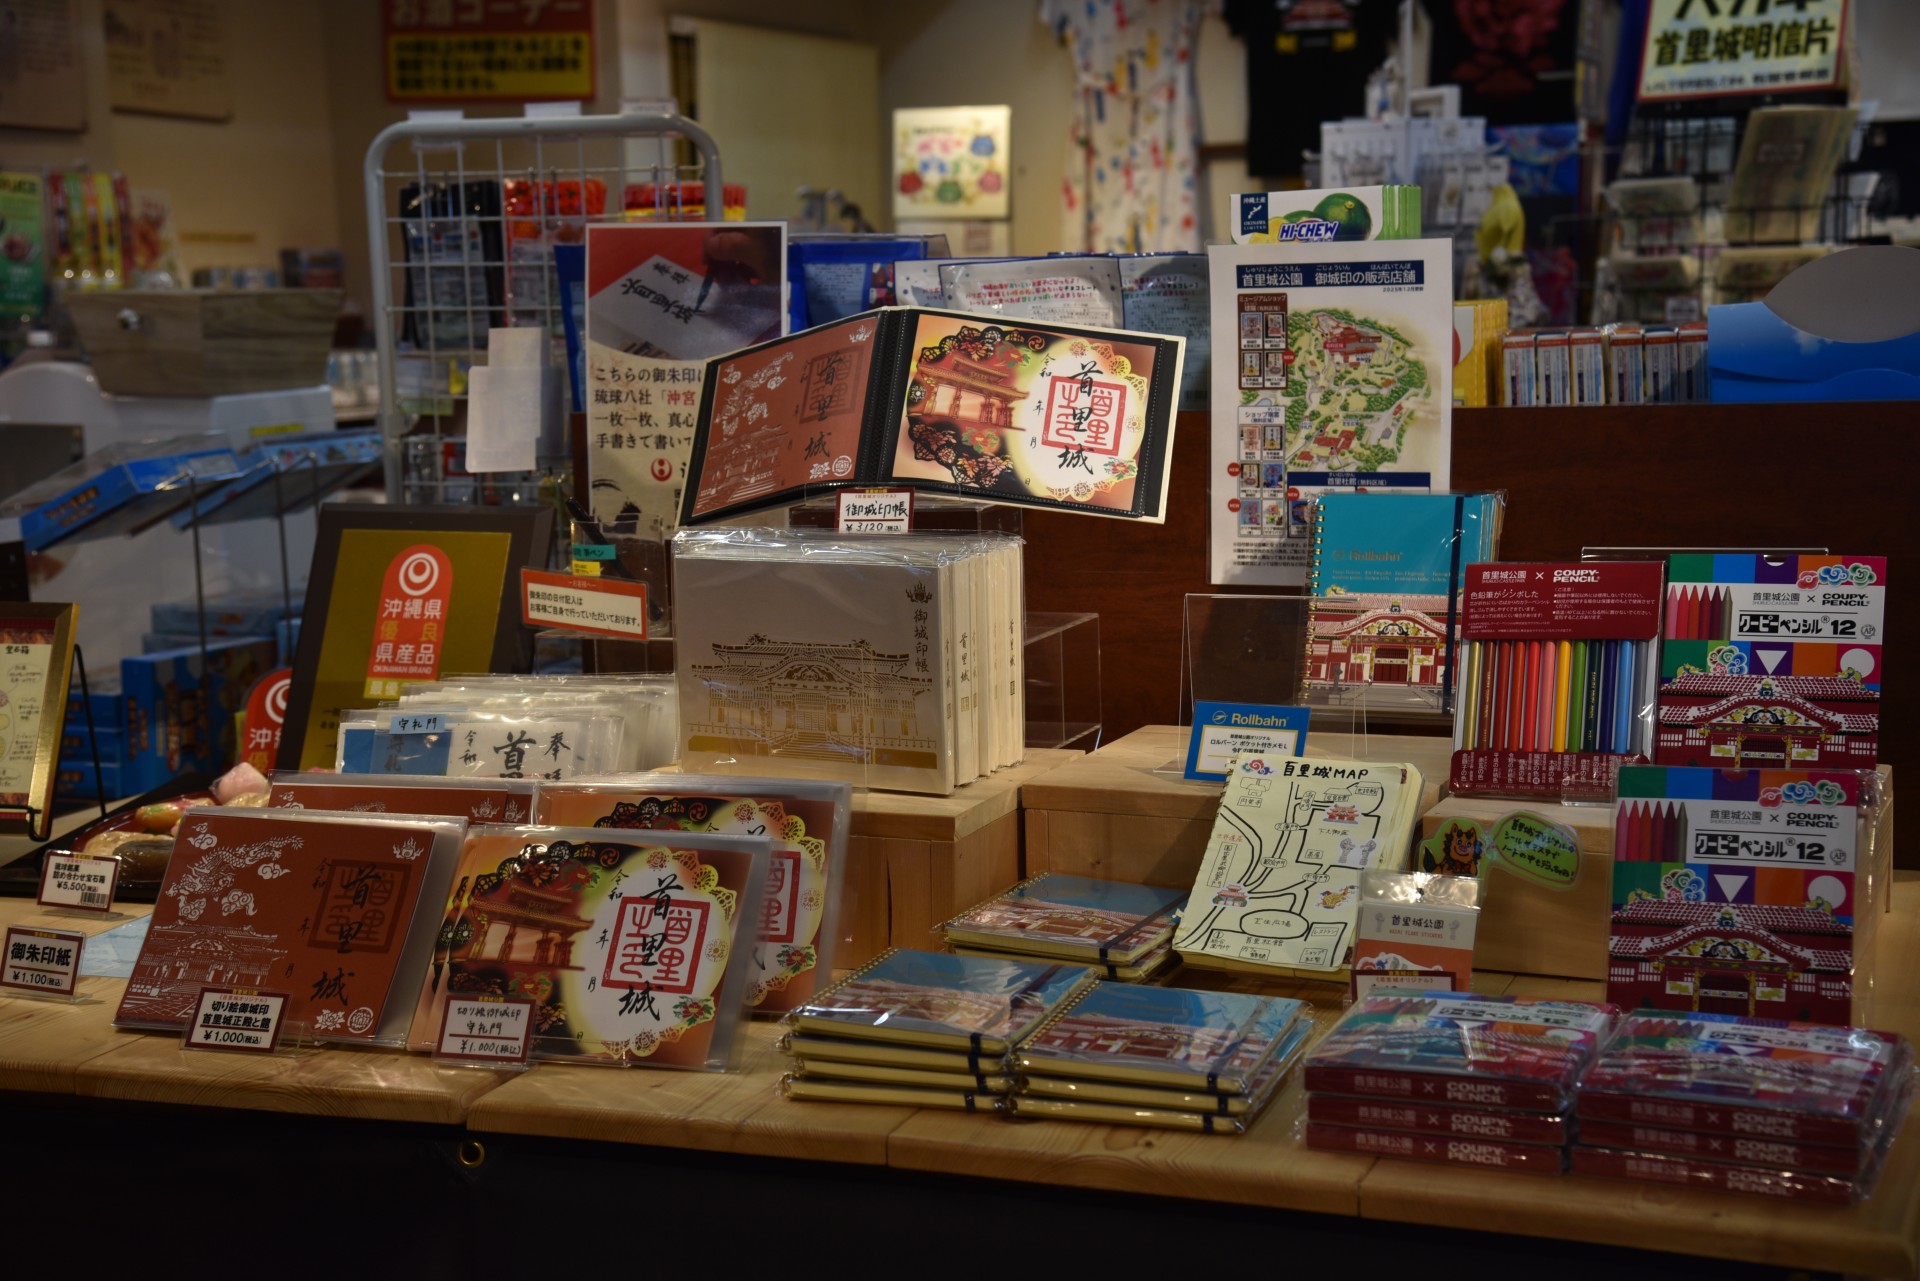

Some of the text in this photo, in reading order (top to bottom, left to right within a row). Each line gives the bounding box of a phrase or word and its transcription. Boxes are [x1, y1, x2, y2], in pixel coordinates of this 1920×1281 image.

[1654, 18, 1835, 67] 首里城明信片
[1279, 221, 1340, 241] HI-CHEW
[1241, 270, 1417, 287] 首里城公園 御城印の販売店舗
[1039, 353, 1055, 377] 令和
[1033, 400, 1044, 416] 年
[1058, 360, 1104, 475] 首里城
[845, 501, 908, 518] 御城印帳
[1481, 570, 1527, 580] 首里城公園
[1753, 592, 1800, 602] 首里城公園
[1822, 592, 1869, 600] COUPY-
[384, 598, 442, 620] 沖縄県
[1830, 620, 1857, 636] 12
[913, 608, 929, 673] 御城印帳
[375, 643, 436, 665] 県産品
[405, 667, 433, 675] BRAND
[399, 717, 437, 731] 守礼門
[1231, 712, 1287, 728] Rollbahn
[1210, 738, 1238, 746] ロルバーン
[1710, 809, 1763, 821] 首里城公園
[1786, 811, 1838, 821] COUPY-
[1796, 842, 1825, 860] 12
[608, 868, 630, 900] 令和
[1391, 914, 1445, 930] 首里城公園
[310, 863, 383, 1006] 首里城
[596, 928, 609, 950] 年
[11, 942, 72, 967] 御朱印紙
[618, 873, 684, 1021] 首里城
[587, 976, 597, 993] 月
[211, 1000, 270, 1015] 切り絵御城印
[466, 1021, 503, 1036] 守礼門
